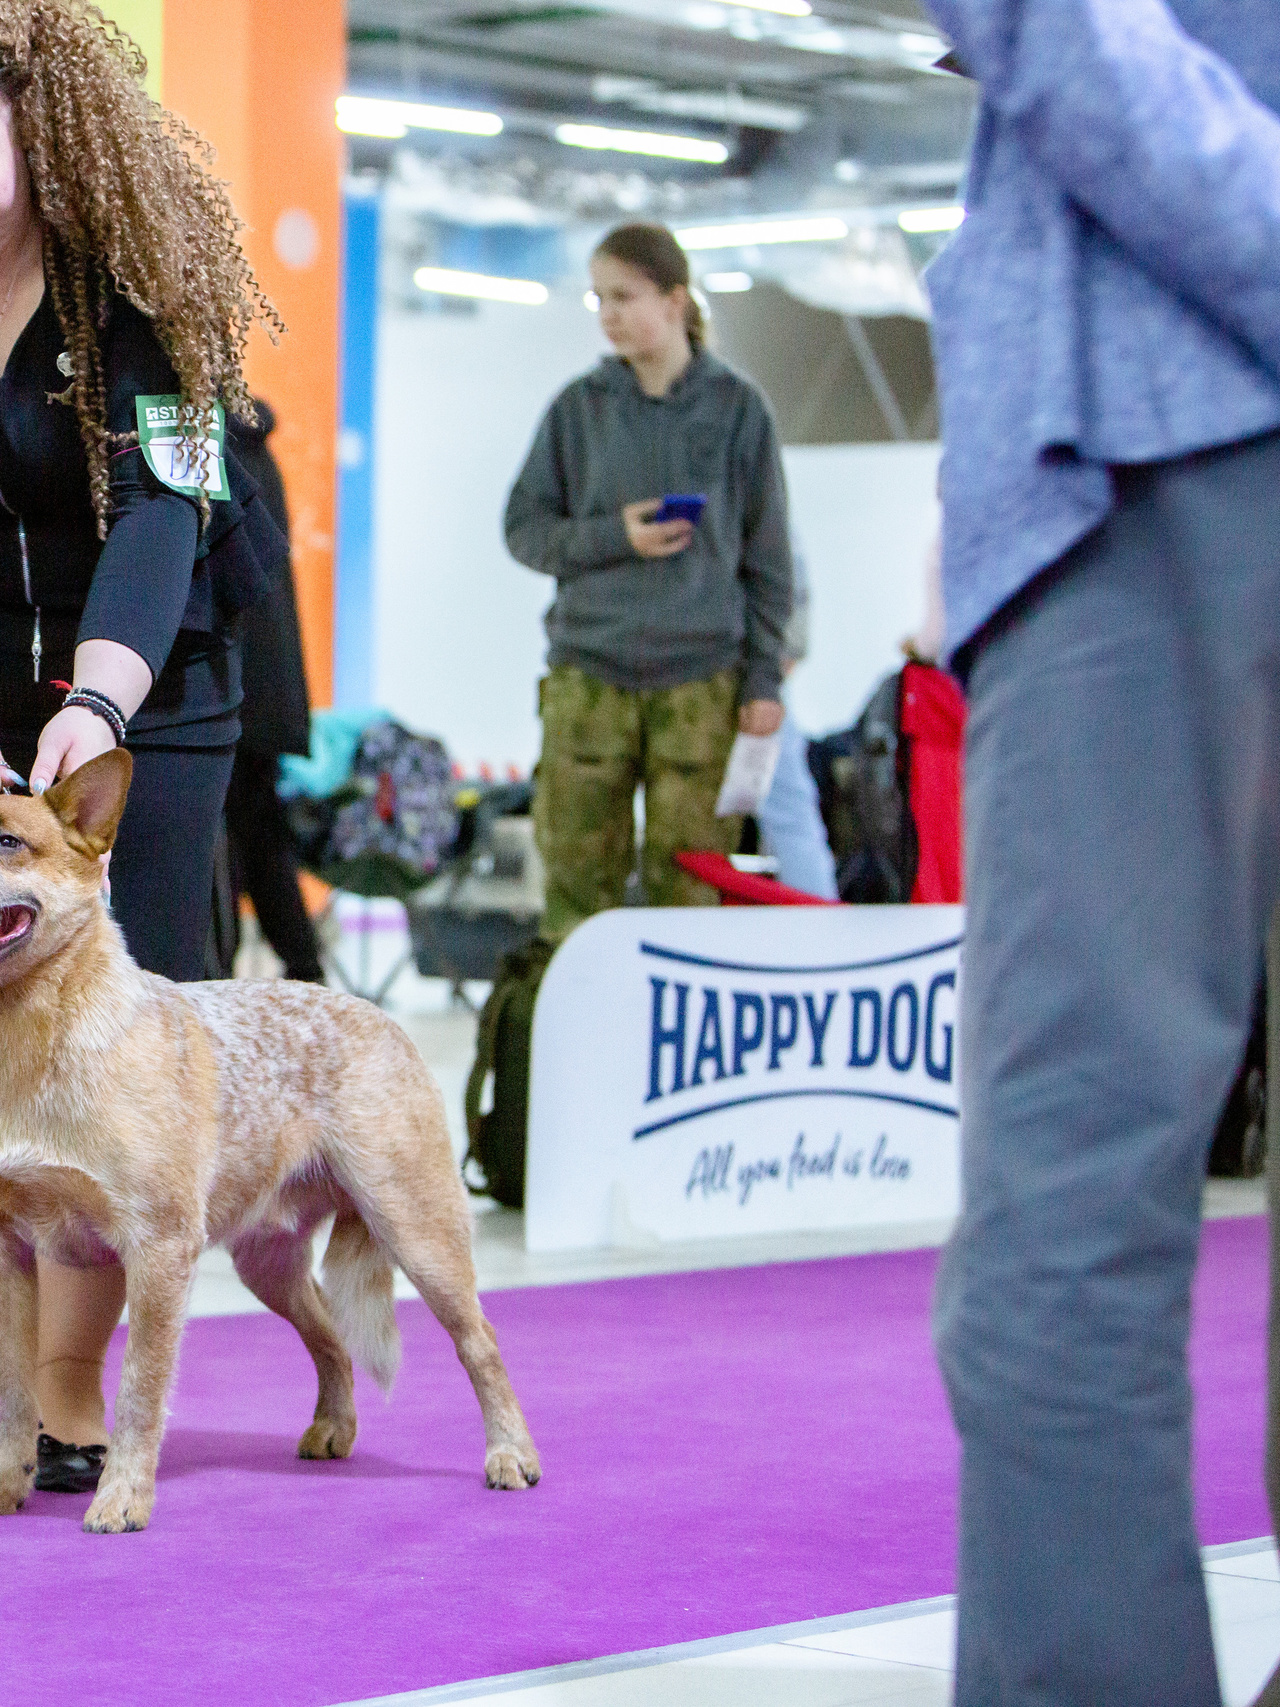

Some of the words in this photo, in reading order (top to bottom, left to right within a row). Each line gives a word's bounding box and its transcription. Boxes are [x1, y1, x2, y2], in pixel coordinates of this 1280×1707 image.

[643, 973, 839, 1105] HAPPY
[847, 970, 956, 1084] DOG
[685, 1141, 735, 1199] All
